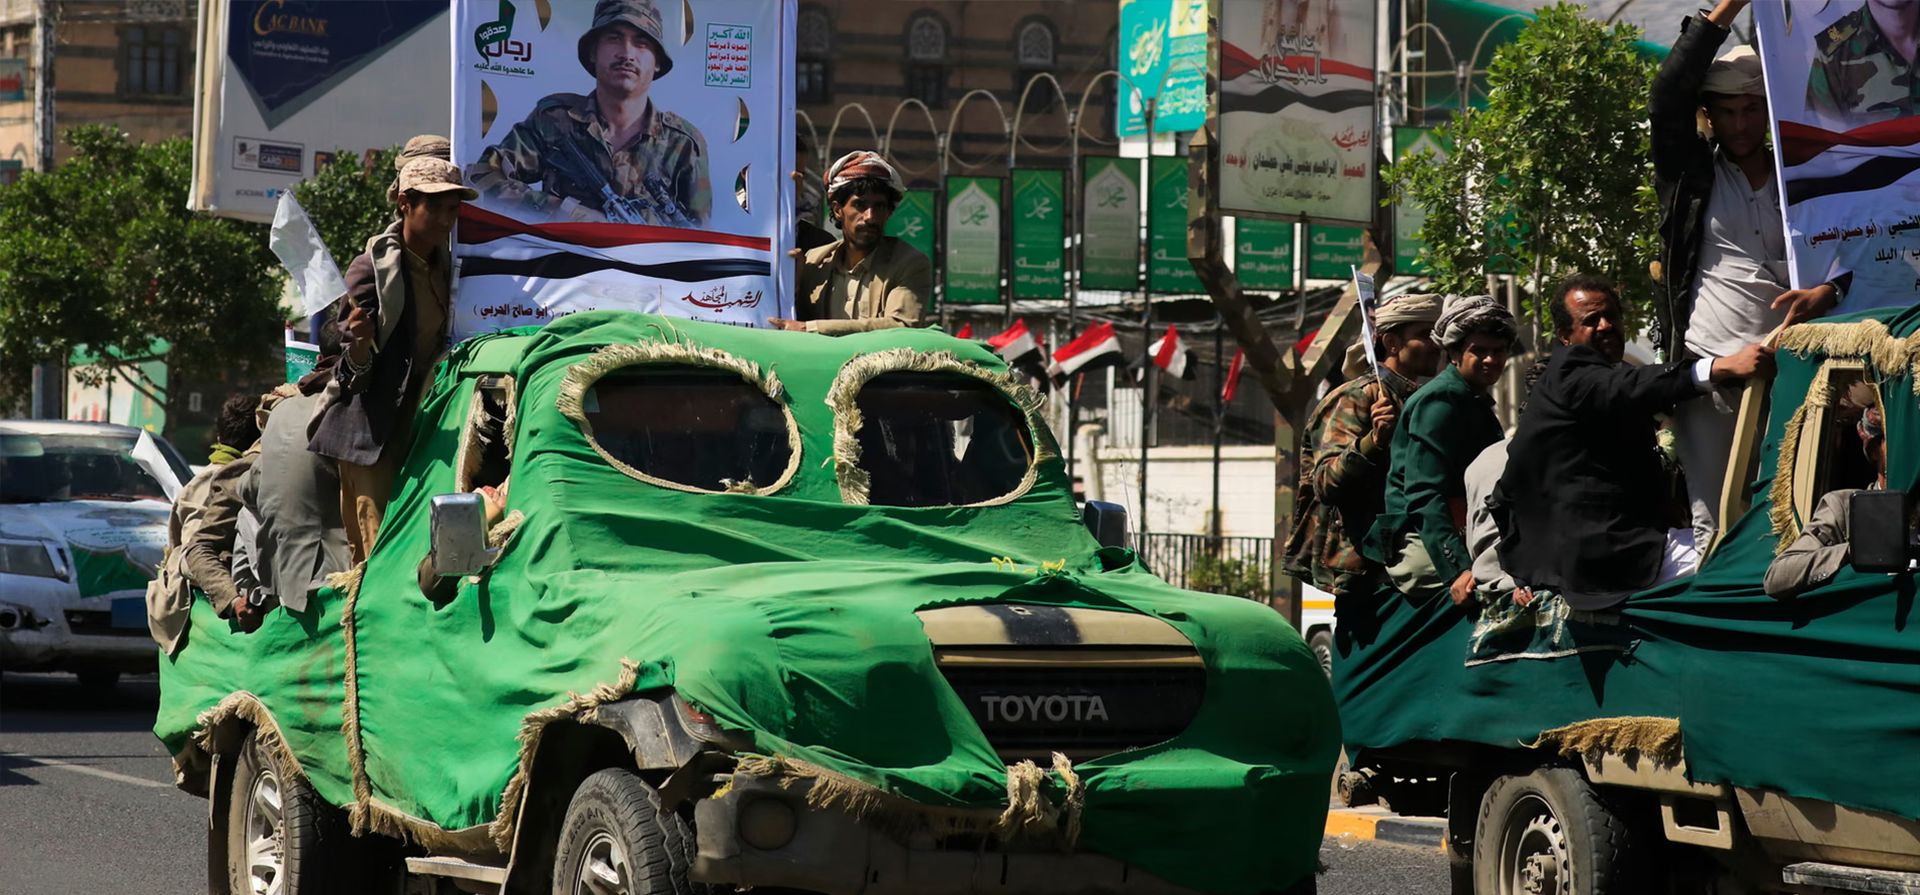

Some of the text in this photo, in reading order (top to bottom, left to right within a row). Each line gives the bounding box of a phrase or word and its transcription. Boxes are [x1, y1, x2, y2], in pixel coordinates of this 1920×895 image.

[253, 0, 329, 36] CAC BANK
[479, 25, 507, 40] صدقوا
[734, 29, 750, 40] الله
[485, 40, 532, 62] رجال
[474, 62, 535, 75] ما عاهدوا الله عليه
[1841, 226, 1863, 242] حسين
[1875, 247, 1898, 264] البلد
[512, 304, 533, 318] صالح
[981, 695, 1109, 722] TOYOTA
